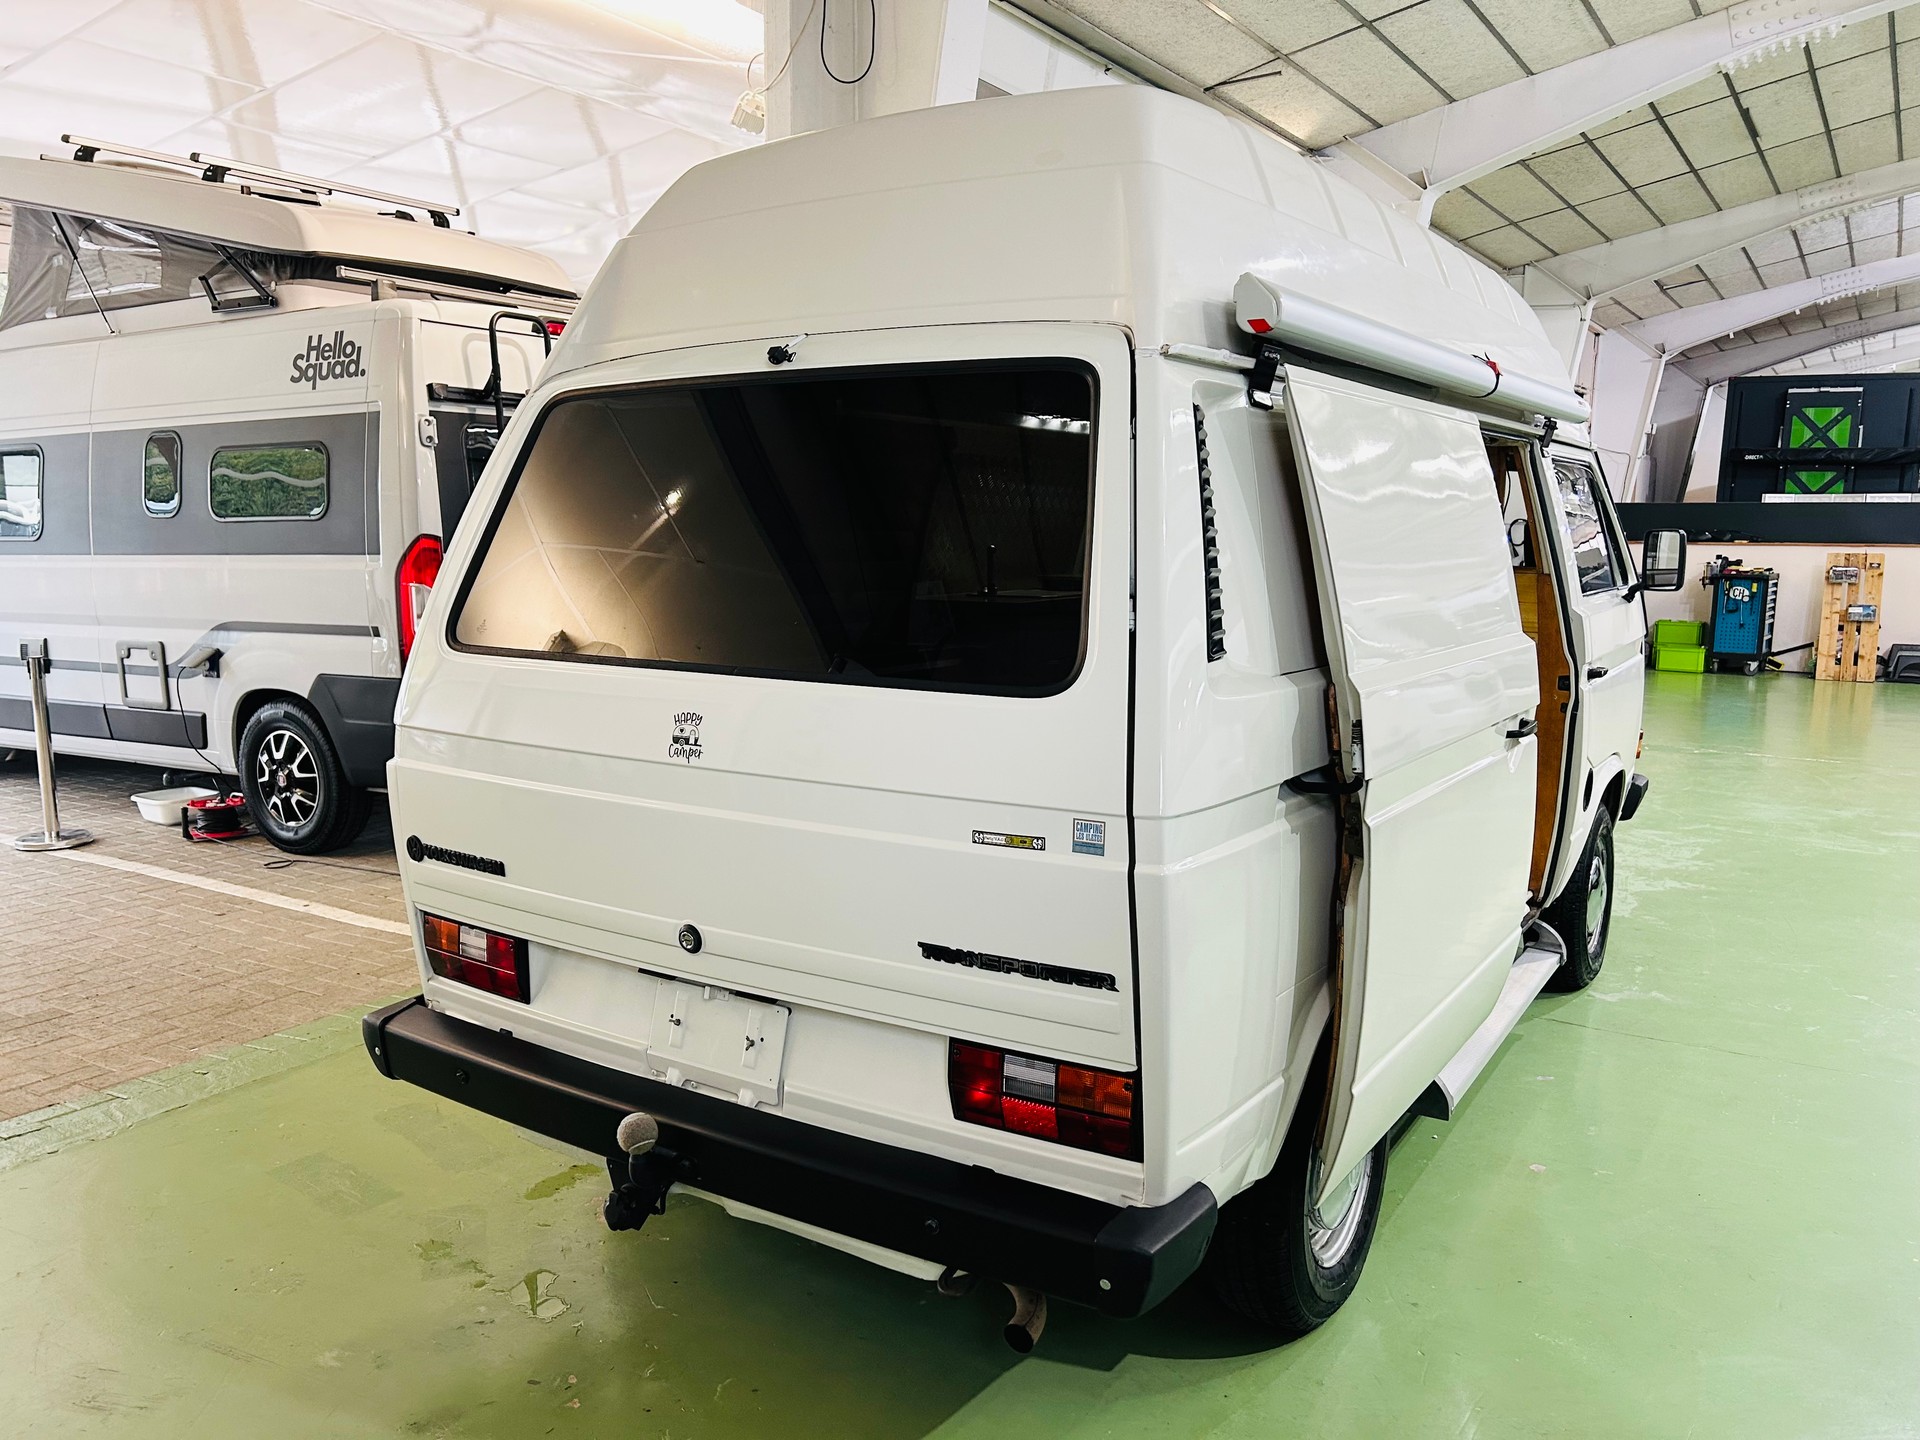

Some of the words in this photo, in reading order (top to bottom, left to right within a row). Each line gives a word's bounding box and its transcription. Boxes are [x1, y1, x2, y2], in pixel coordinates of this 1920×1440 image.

[306, 330, 356, 362] Hello
[290, 346, 366, 390] Squad.
[673, 711, 703, 726] HAPPY
[668, 743, 703, 764] Camper
[1075, 821, 1103, 835] CAMPING
[1075, 832, 1085, 840] LES
[420, 842, 506, 877] VOLKSWAGEN
[917, 941, 1119, 992] TRANSPORTER
